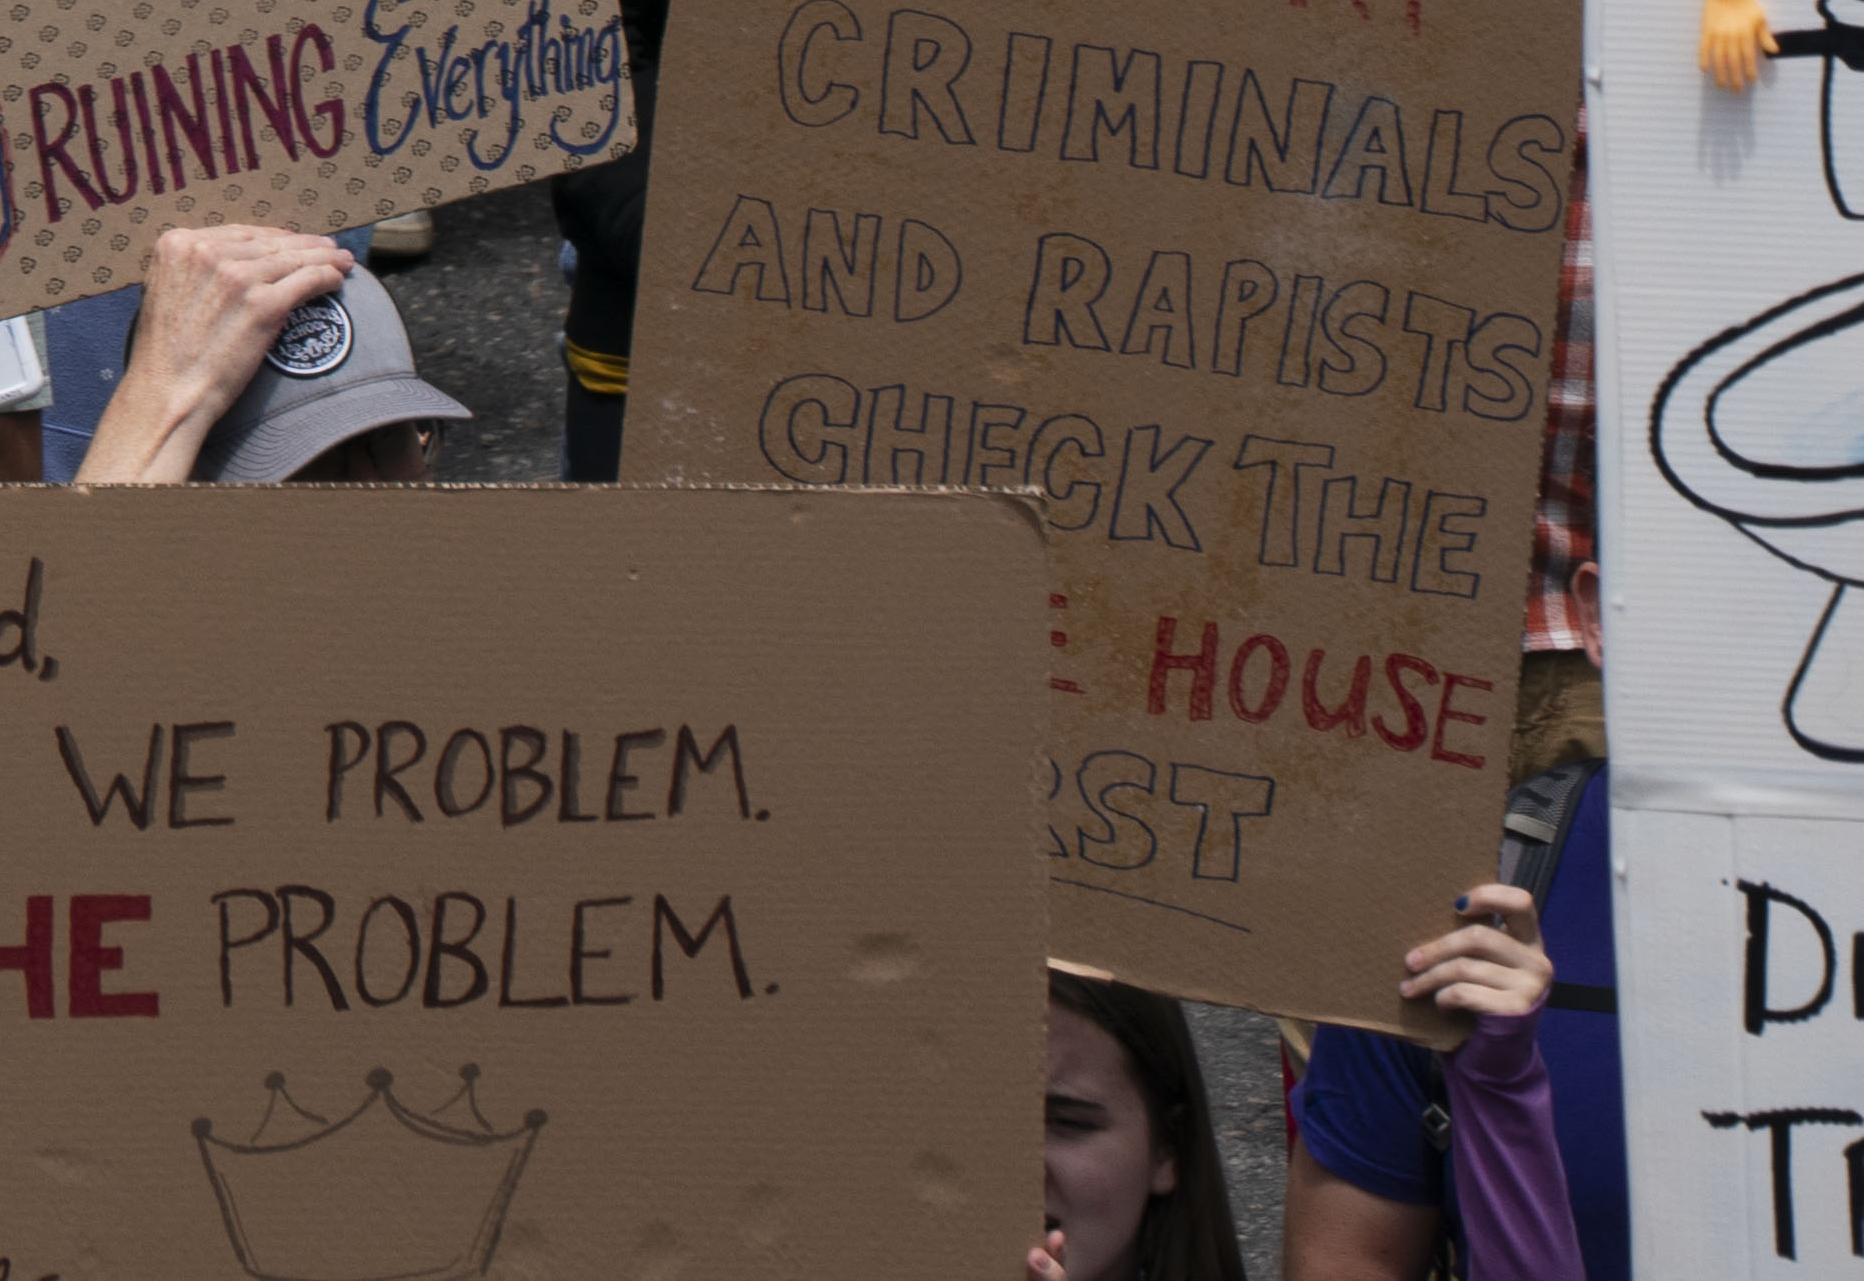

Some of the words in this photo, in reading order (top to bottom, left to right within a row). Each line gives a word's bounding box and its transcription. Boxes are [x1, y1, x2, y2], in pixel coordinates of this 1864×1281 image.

[29, 23, 345, 223] RUINING
[692, 193, 965, 322] AND
[1021, 233, 1545, 423] RAPISTS
[757, 372, 1214, 554] CHECK
[1234, 435, 1488, 599] THE
[55, 720, 235, 832] WE
[325, 719, 770, 827] PROBLEM.
[1145, 616, 1497, 769] HOUSE
[210, 887, 779, 1010] PROBLEM.
